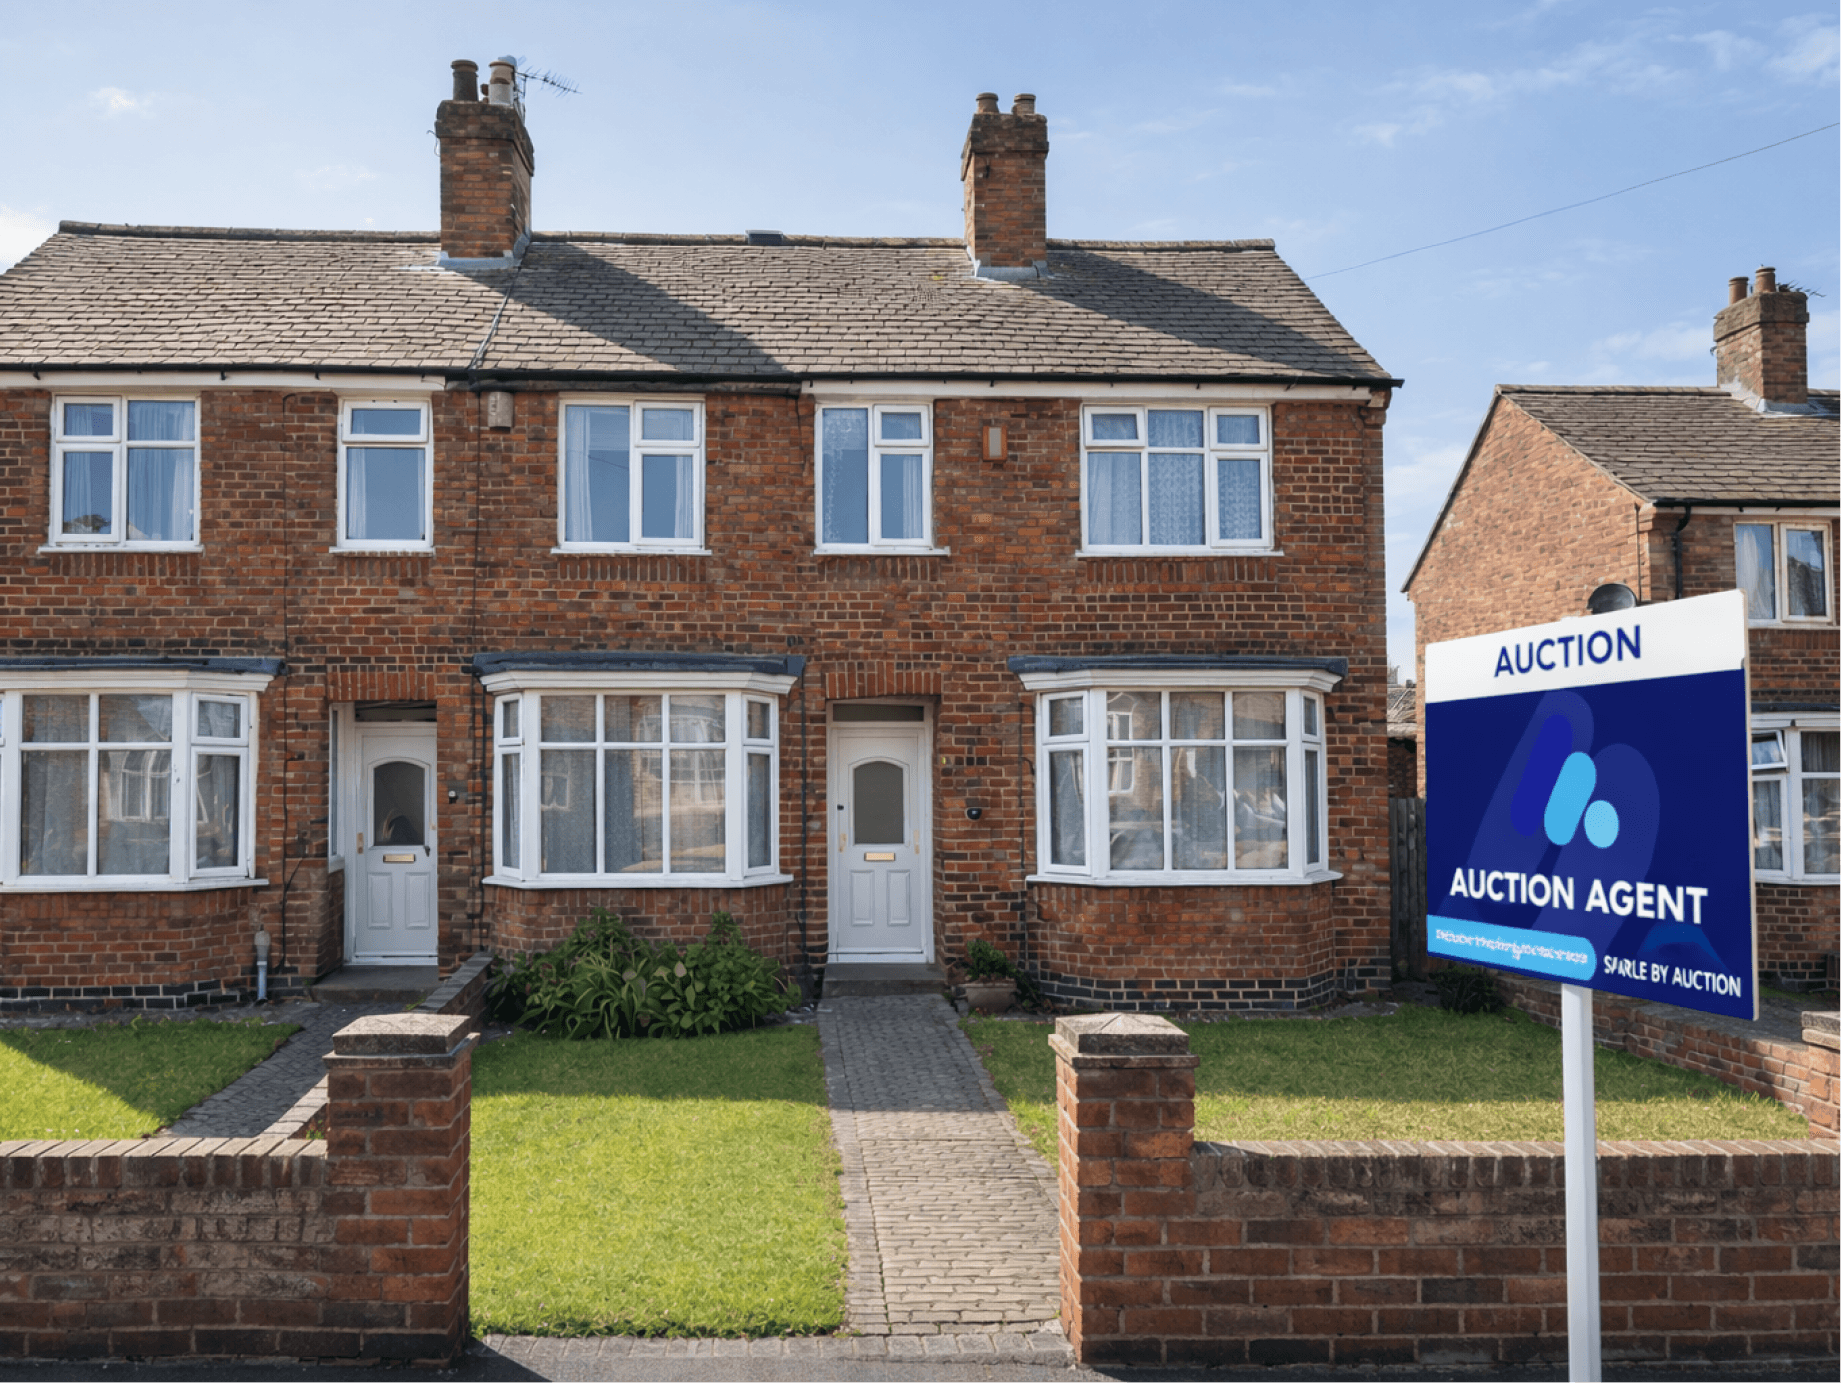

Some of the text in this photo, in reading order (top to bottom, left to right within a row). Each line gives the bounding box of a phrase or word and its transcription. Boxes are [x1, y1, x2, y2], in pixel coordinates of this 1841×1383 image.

[1494, 625, 1641, 678] AUCTION
[1449, 867, 1709, 925] AUCTION AGENT
[1651, 963, 1669, 984] BY
[1672, 967, 1742, 998] AUCTION
